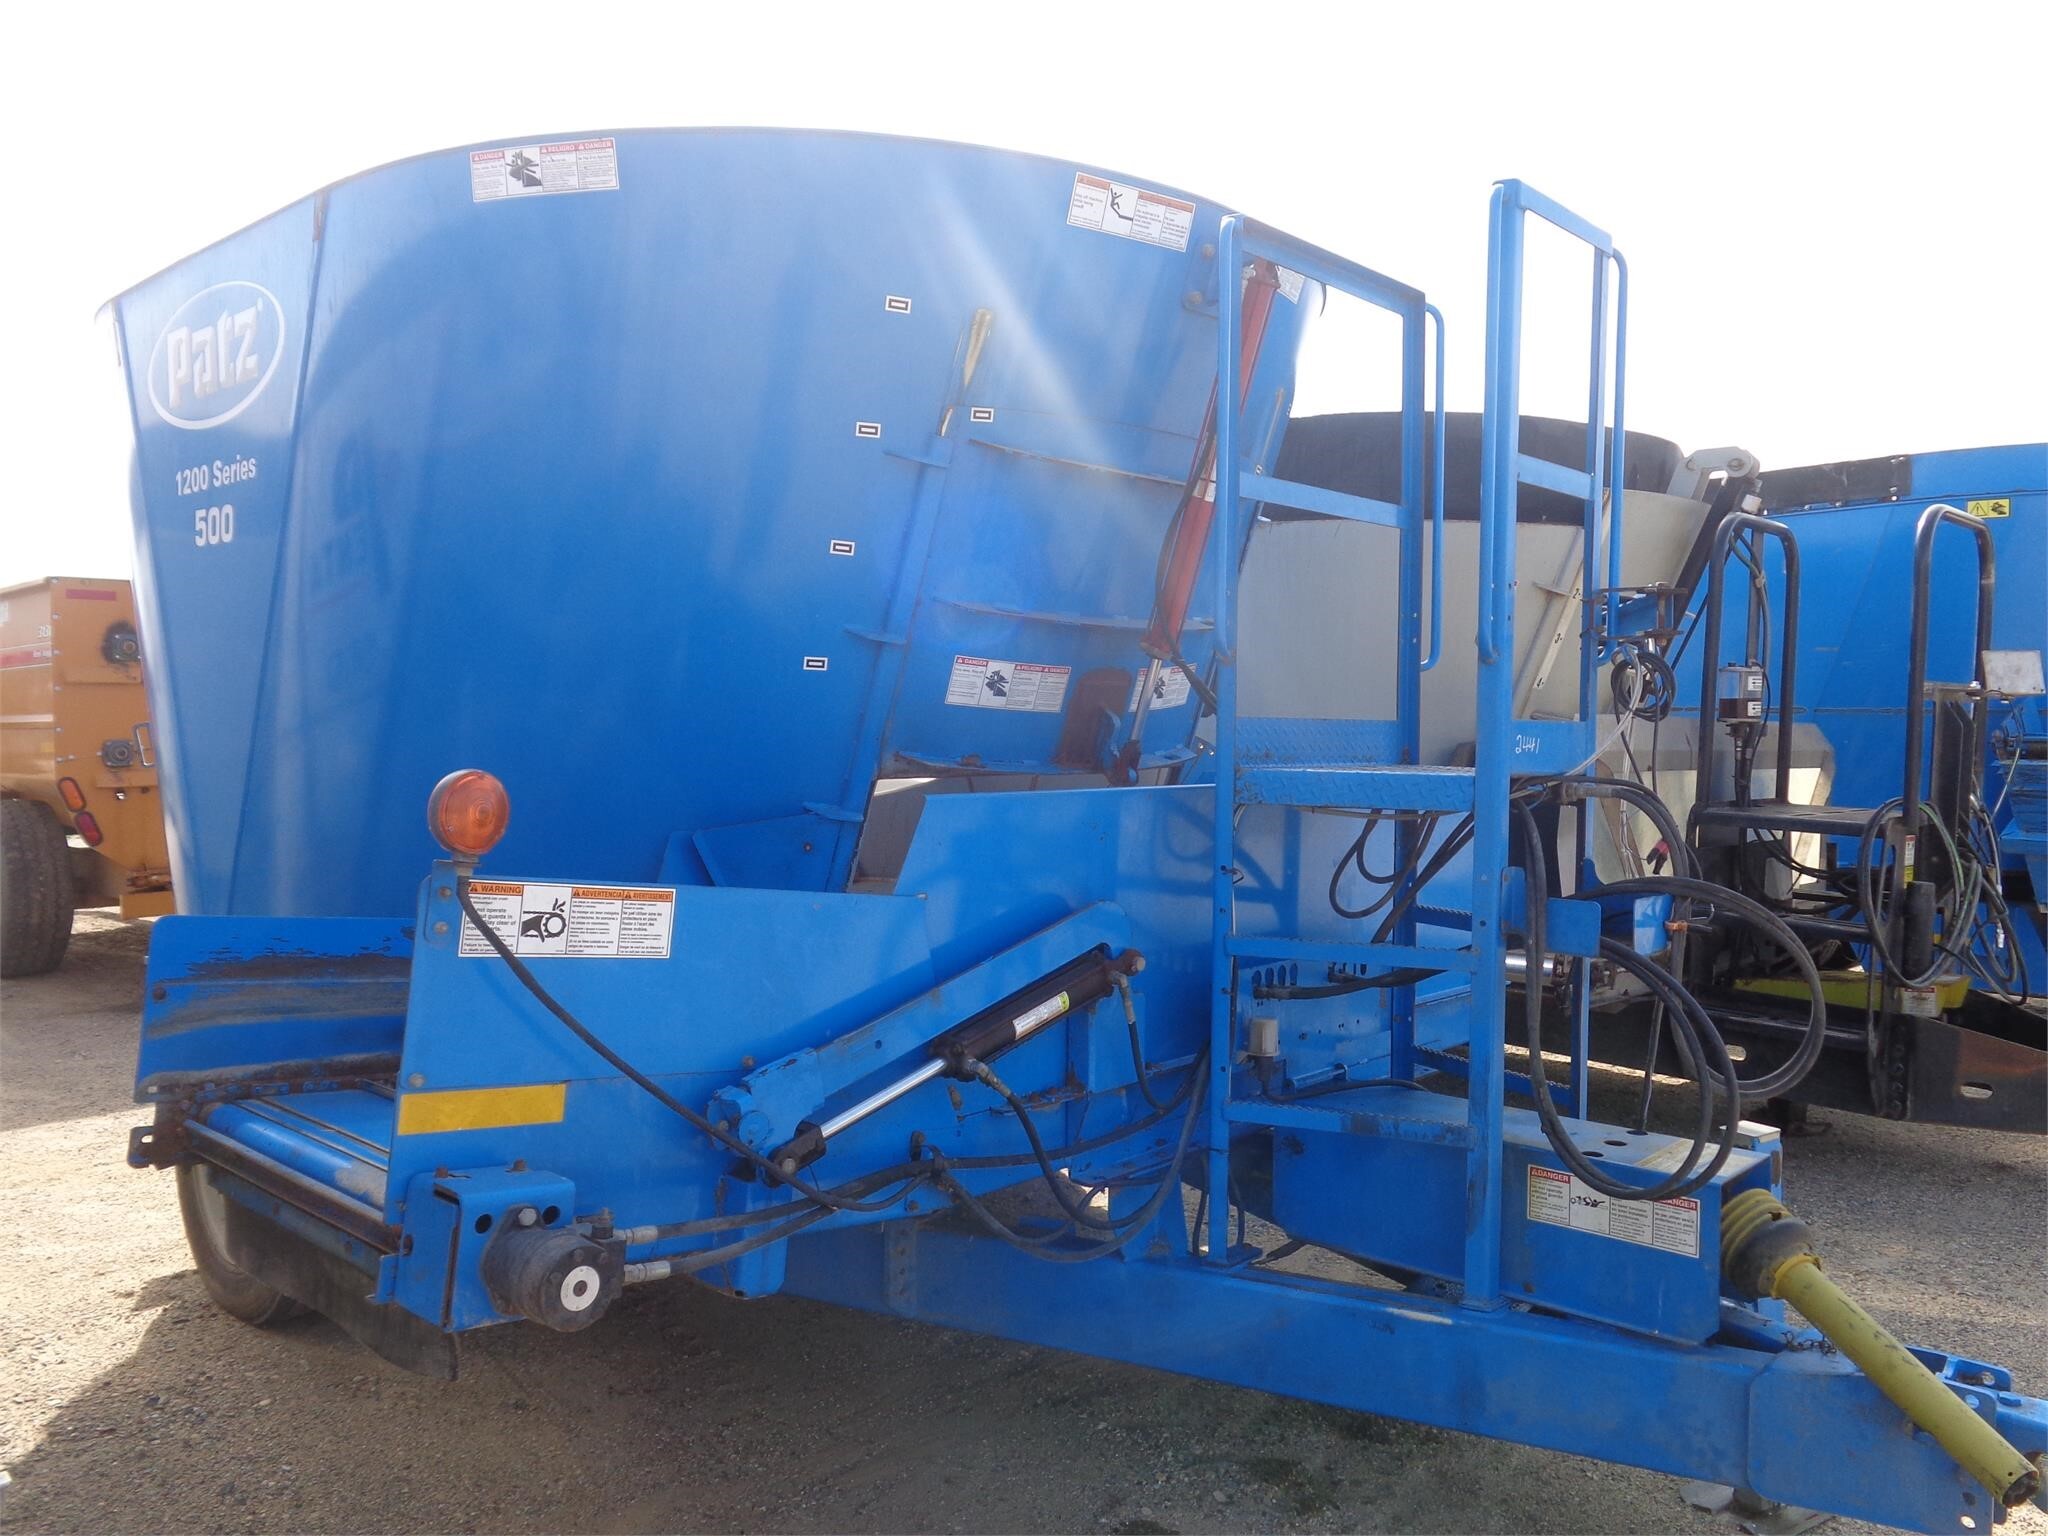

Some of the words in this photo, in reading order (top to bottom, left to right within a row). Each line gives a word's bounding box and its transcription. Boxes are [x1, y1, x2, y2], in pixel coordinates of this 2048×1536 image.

[175, 466, 208, 496] 1200
[212, 454, 257, 487] Series
[194, 504, 233, 547] 500
[964, 658, 987, 666] DANGER
[1515, 734, 1540, 754] 2441
[480, 884, 522, 894] WARNING
[581, 889, 623, 898] ADVERTENCIA
[1537, 1169, 1569, 1182] DANGER
[1661, 1198, 1697, 1209] ANGER
